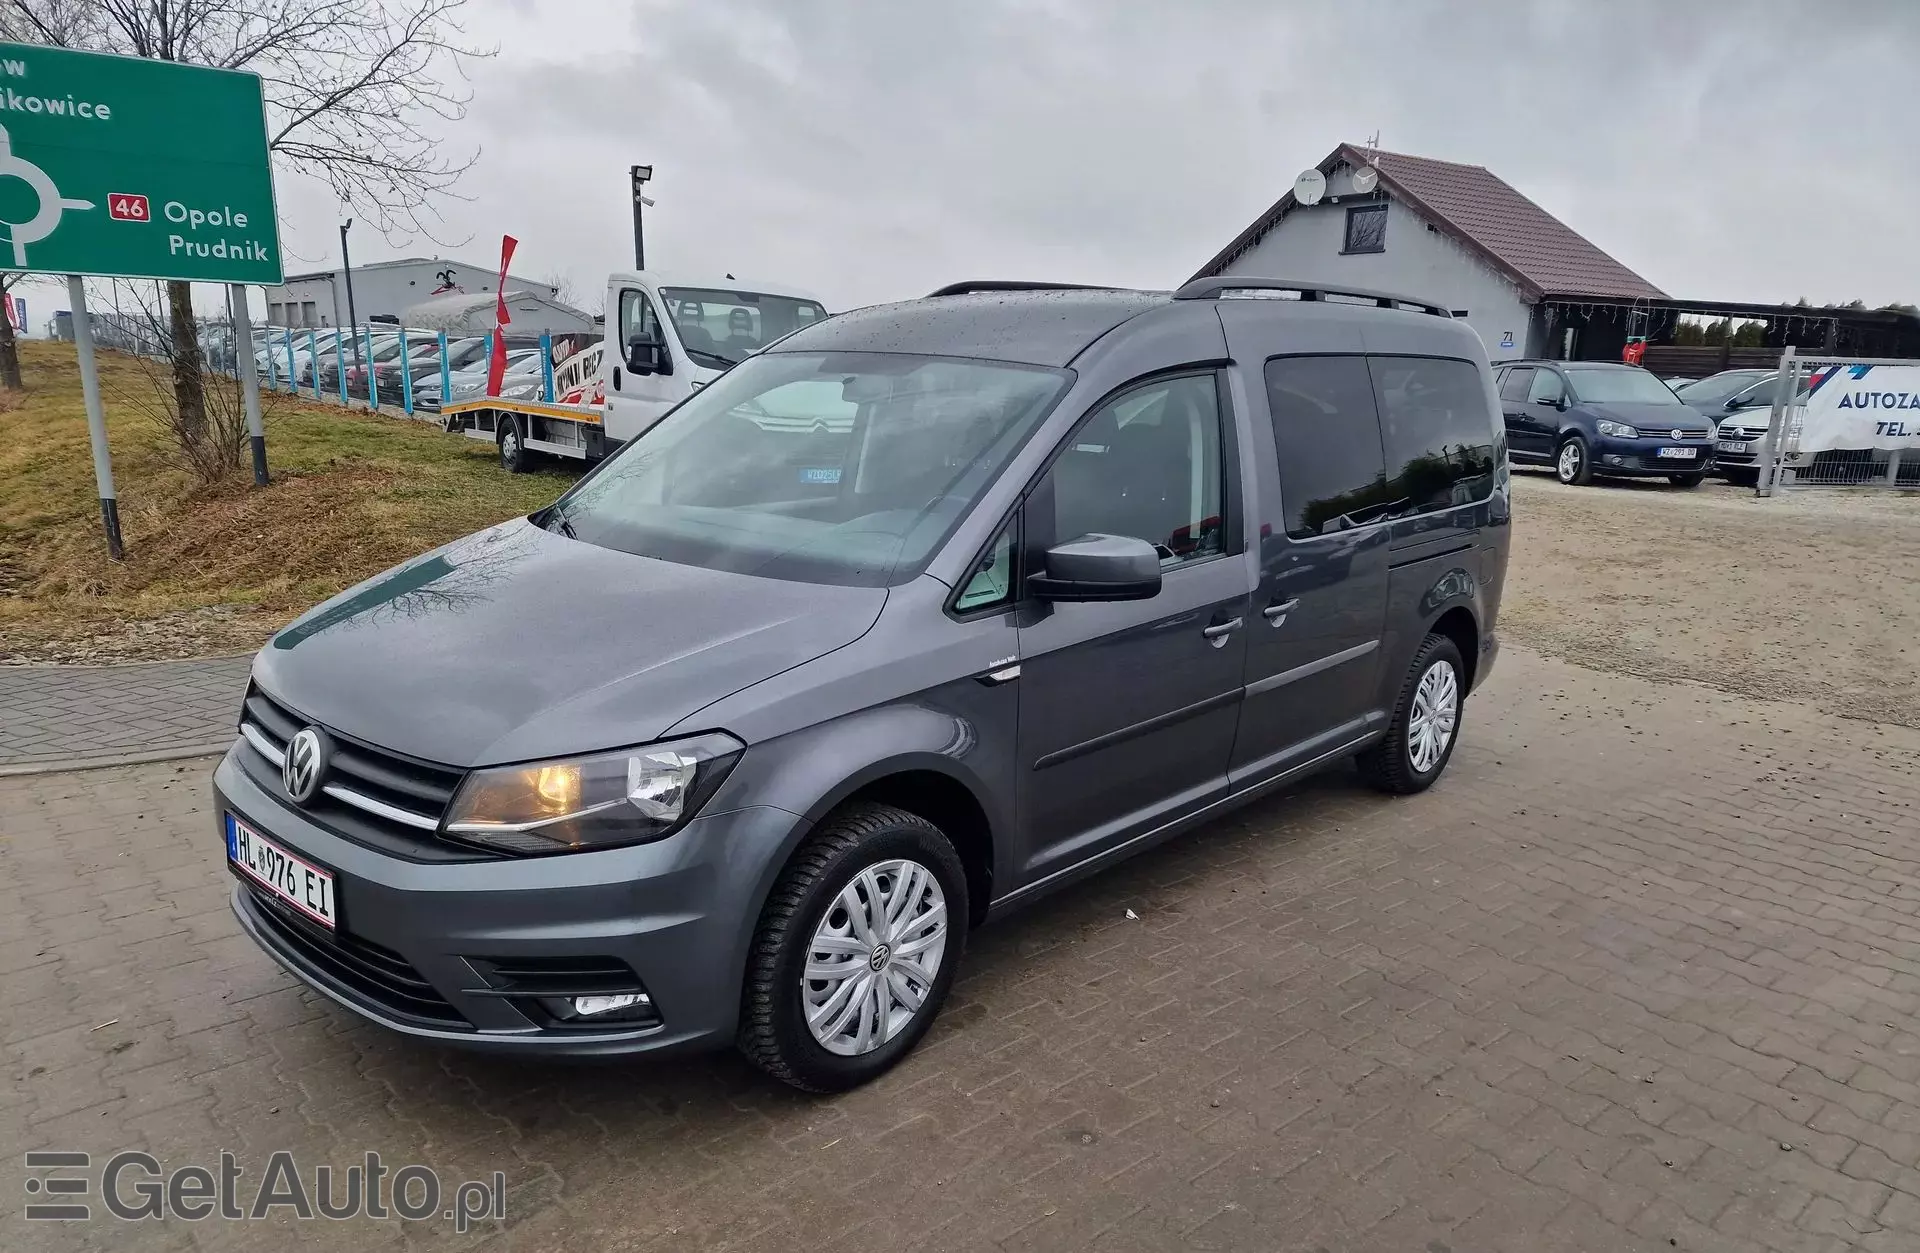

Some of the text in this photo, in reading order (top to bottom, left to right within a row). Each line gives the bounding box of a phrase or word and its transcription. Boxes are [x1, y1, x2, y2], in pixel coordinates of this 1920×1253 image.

[115, 198, 144, 218] 46
[164, 201, 248, 230] Opole
[169, 234, 268, 262] Prudnik
[1503, 331, 1513, 341] 71
[1838, 392, 1920, 409] AUTOZA
[1876, 421, 1912, 437] TEL.
[238, 826, 256, 871] HL
[267, 846, 296, 896] 976
[305, 868, 329, 917] EI
